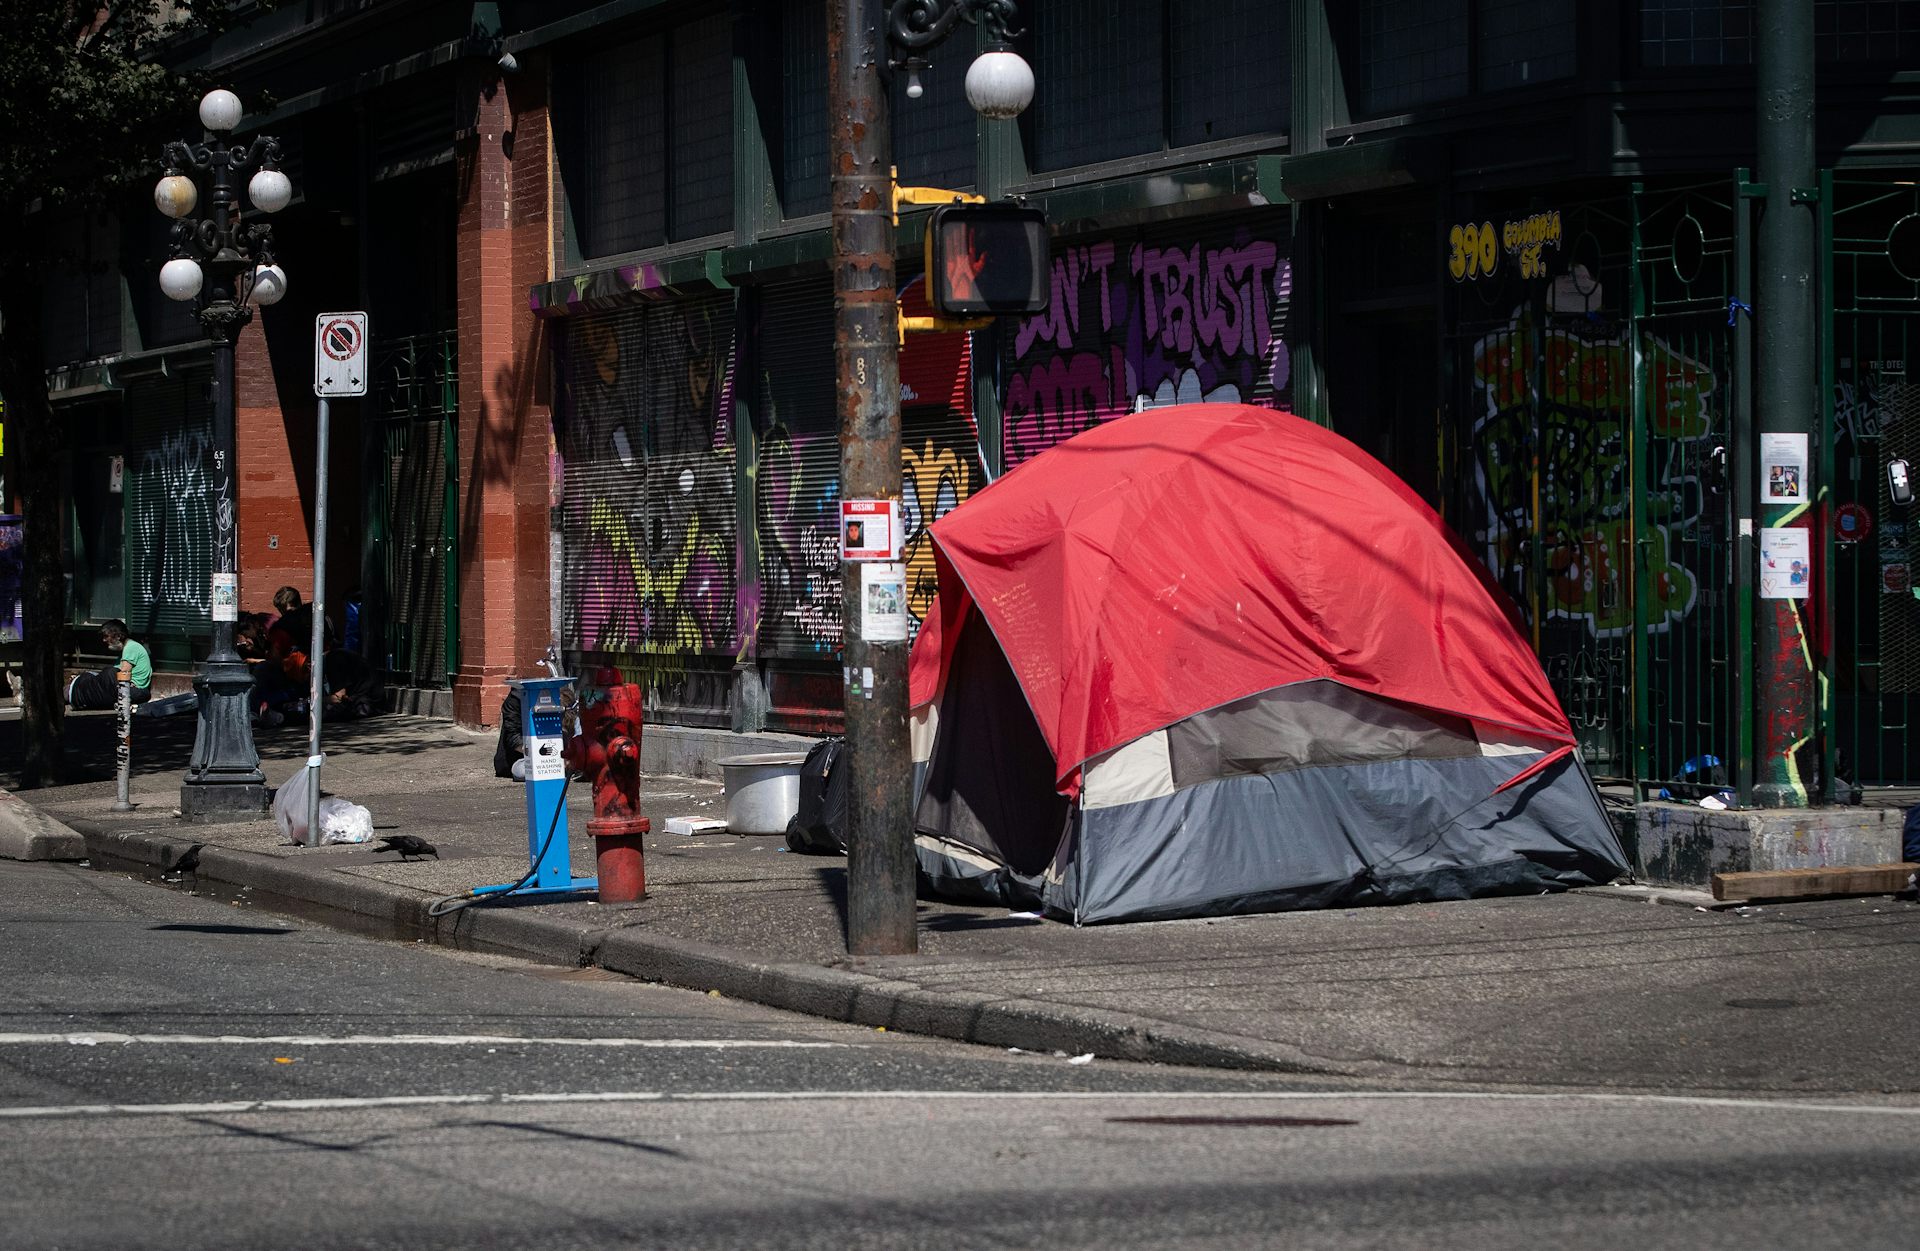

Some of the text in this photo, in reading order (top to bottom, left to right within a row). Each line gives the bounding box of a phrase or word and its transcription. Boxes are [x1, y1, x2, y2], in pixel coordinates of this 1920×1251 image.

[1448, 220, 1499, 283] 390
[1131, 239, 1277, 362] TRUST
[851, 503, 875, 512] MISSING
